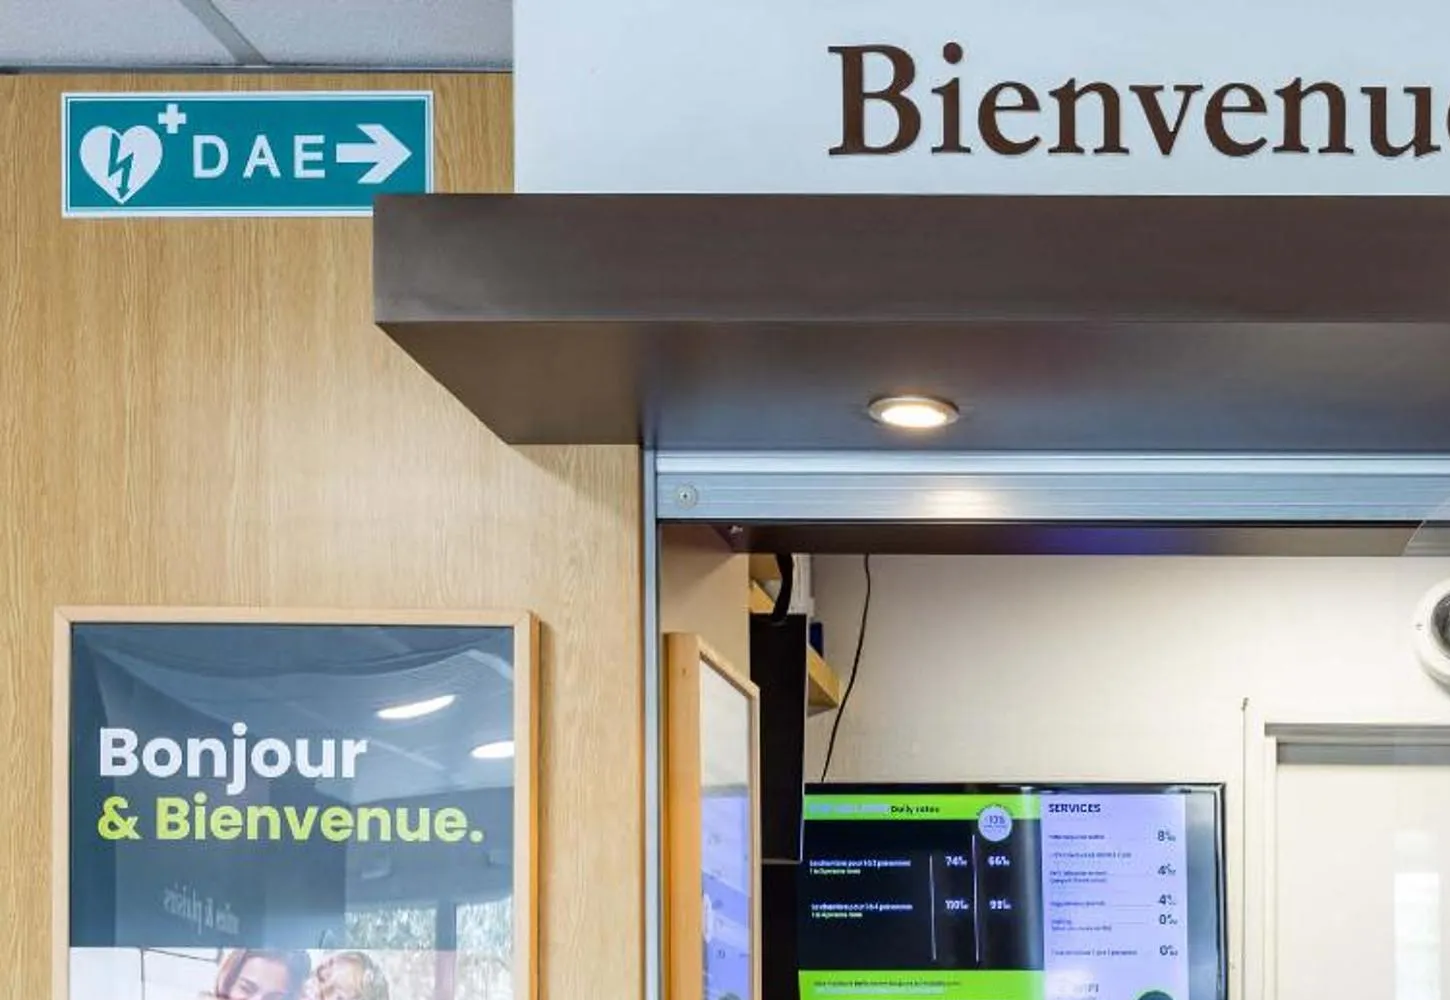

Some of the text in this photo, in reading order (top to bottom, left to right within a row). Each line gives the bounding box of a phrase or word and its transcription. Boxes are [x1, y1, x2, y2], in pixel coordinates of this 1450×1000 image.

[193, 134, 326, 179] DAE
[99, 722, 367, 796] Bonjour
[97, 793, 484, 843] & Bienvenue.
[1048, 803, 1102, 814] SERVICES
